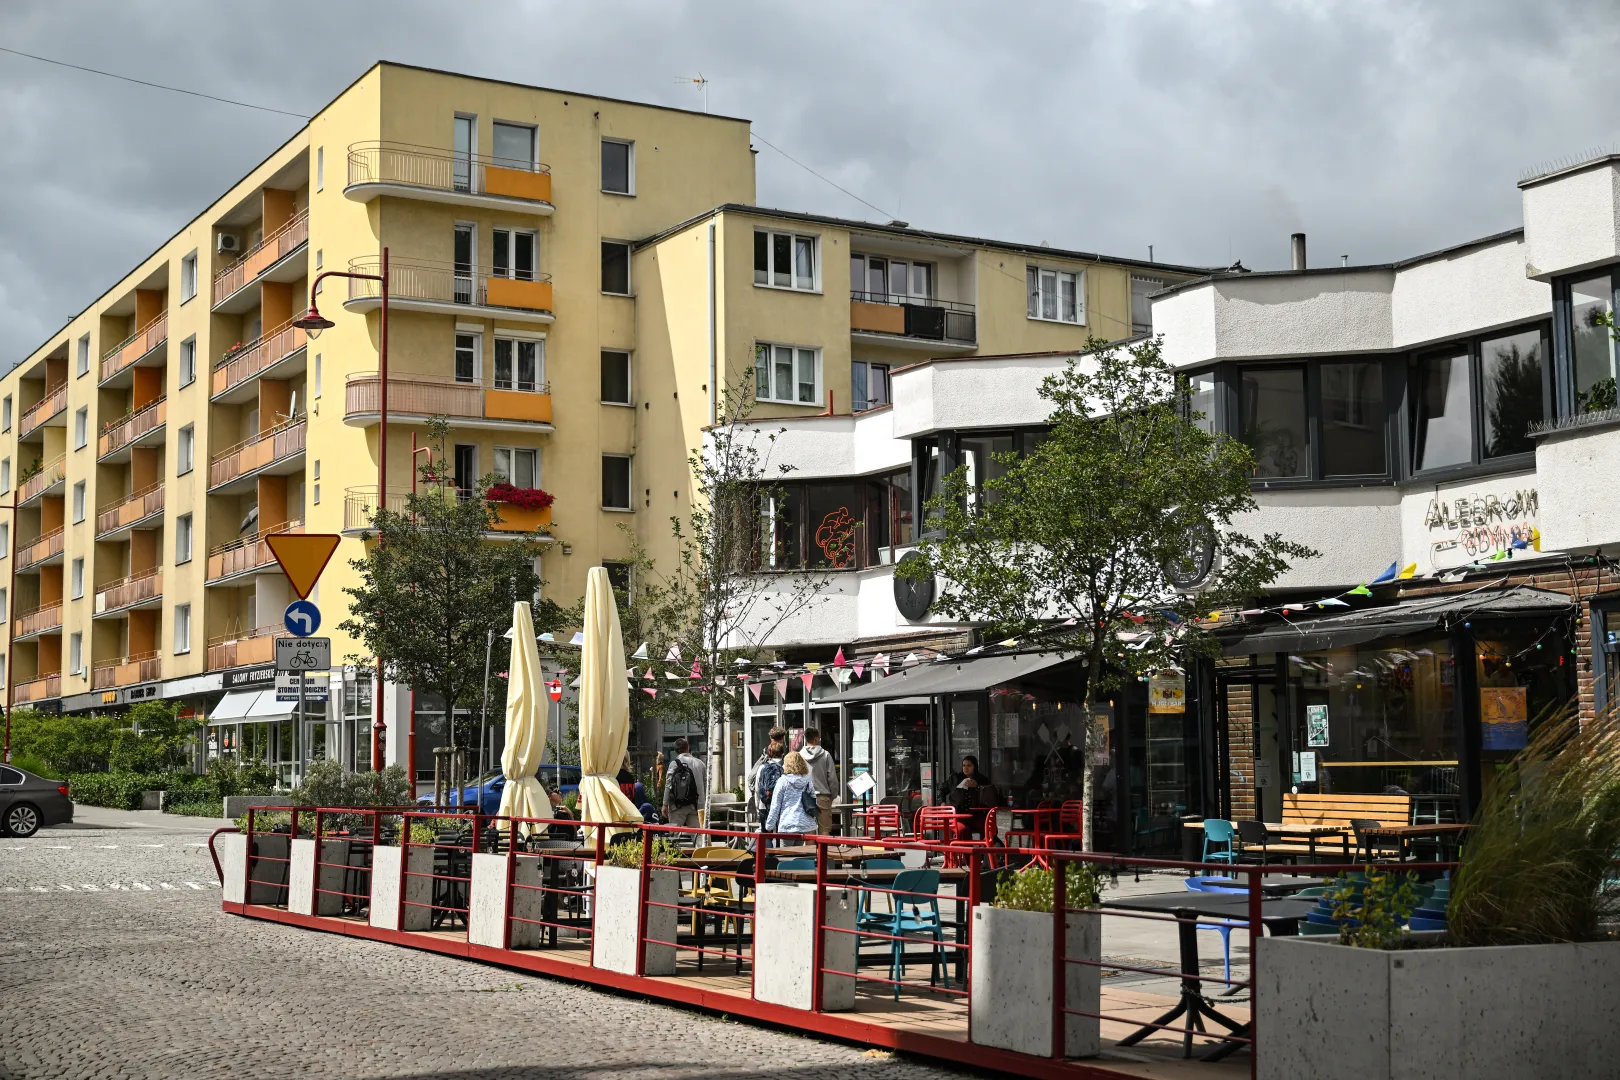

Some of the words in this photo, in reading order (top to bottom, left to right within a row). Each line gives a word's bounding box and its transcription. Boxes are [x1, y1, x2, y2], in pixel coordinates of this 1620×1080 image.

[278, 640, 293, 648] Nie
[296, 640, 329, 650] dotyczy
[232, 672, 249, 684] SALONY
[277, 686, 327, 694] STOMATOGICZNE
